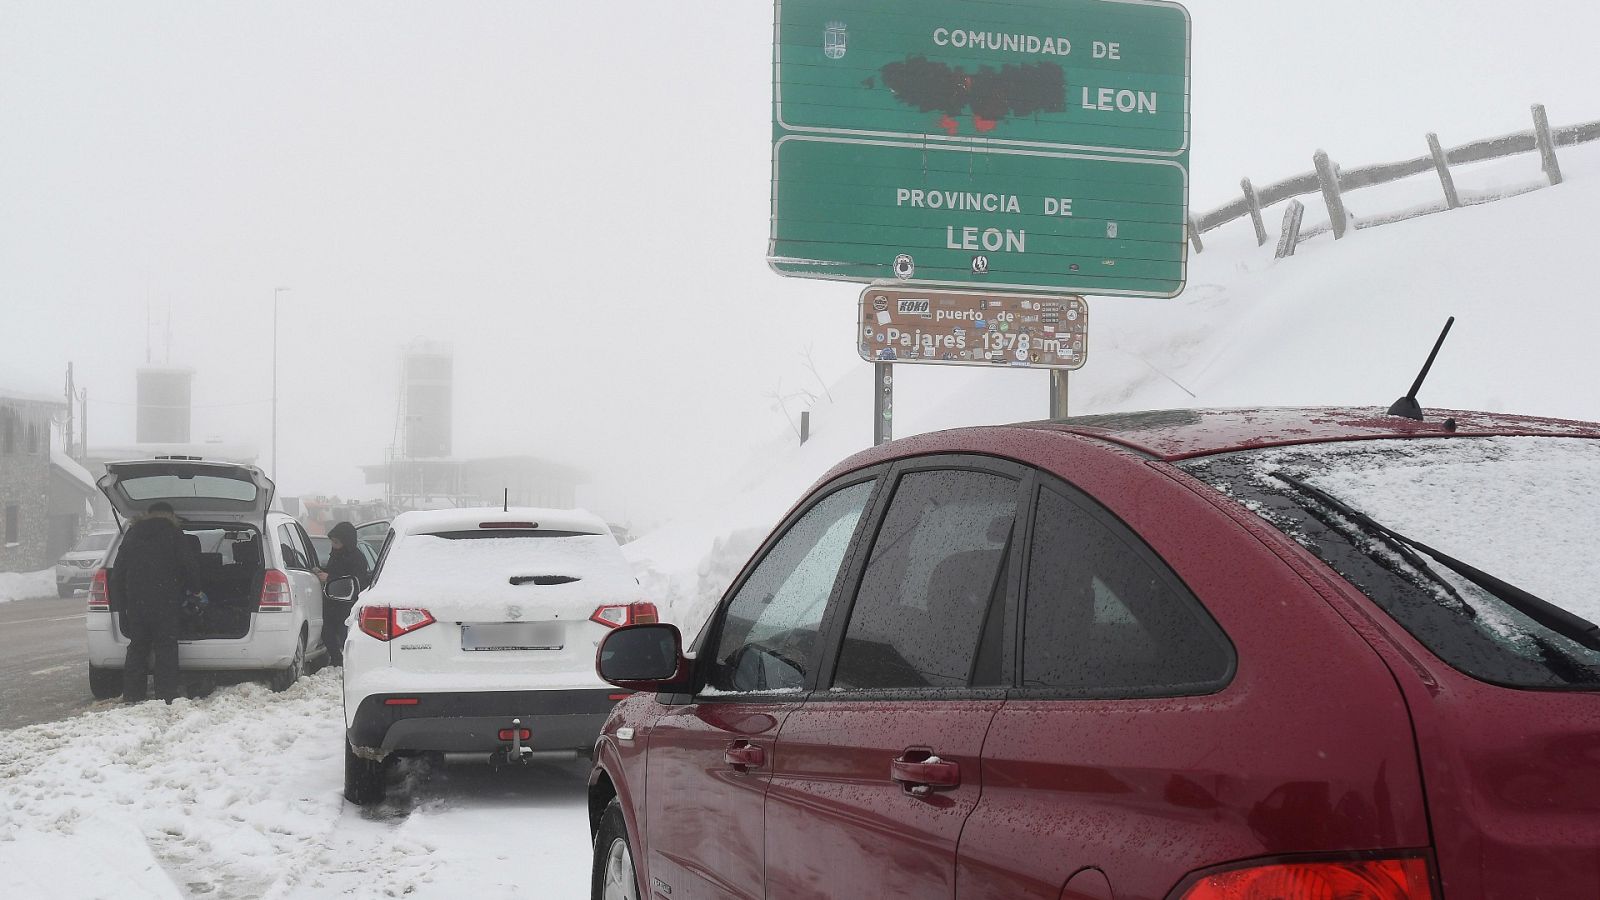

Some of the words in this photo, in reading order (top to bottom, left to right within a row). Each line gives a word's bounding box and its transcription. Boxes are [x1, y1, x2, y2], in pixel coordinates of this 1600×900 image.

[933, 28, 1072, 56] COMUNIDAD
[1092, 41, 1121, 60] DE
[1081, 86, 1157, 114] LEON
[896, 188, 1021, 213] PROVINCIA
[1044, 197, 1073, 216] DE
[946, 225, 1026, 253] LEON
[899, 301, 929, 312] KOKO
[936, 308, 983, 322] puerto
[997, 310, 1014, 322] de
[886, 328, 966, 350] Pajares
[982, 332, 1030, 351] 1378
